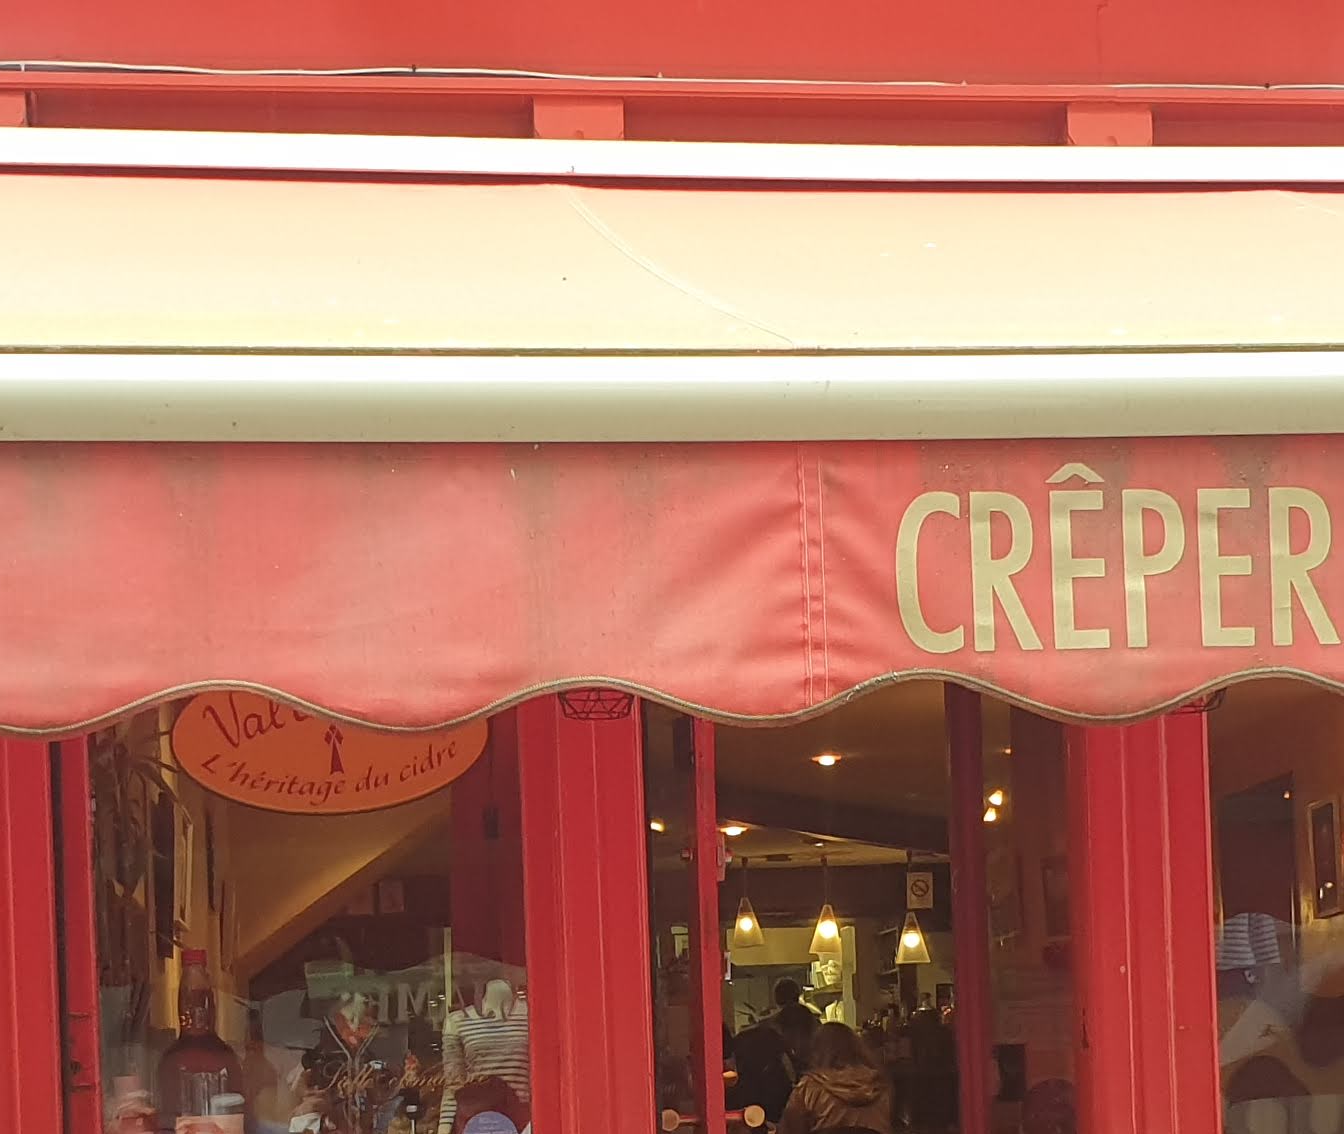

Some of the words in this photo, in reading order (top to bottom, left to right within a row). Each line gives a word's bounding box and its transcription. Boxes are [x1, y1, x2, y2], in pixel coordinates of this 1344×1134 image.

[201, 754, 346, 806] L'héritage
[356, 765, 389, 793] du
[399, 740, 457, 782] cidre
